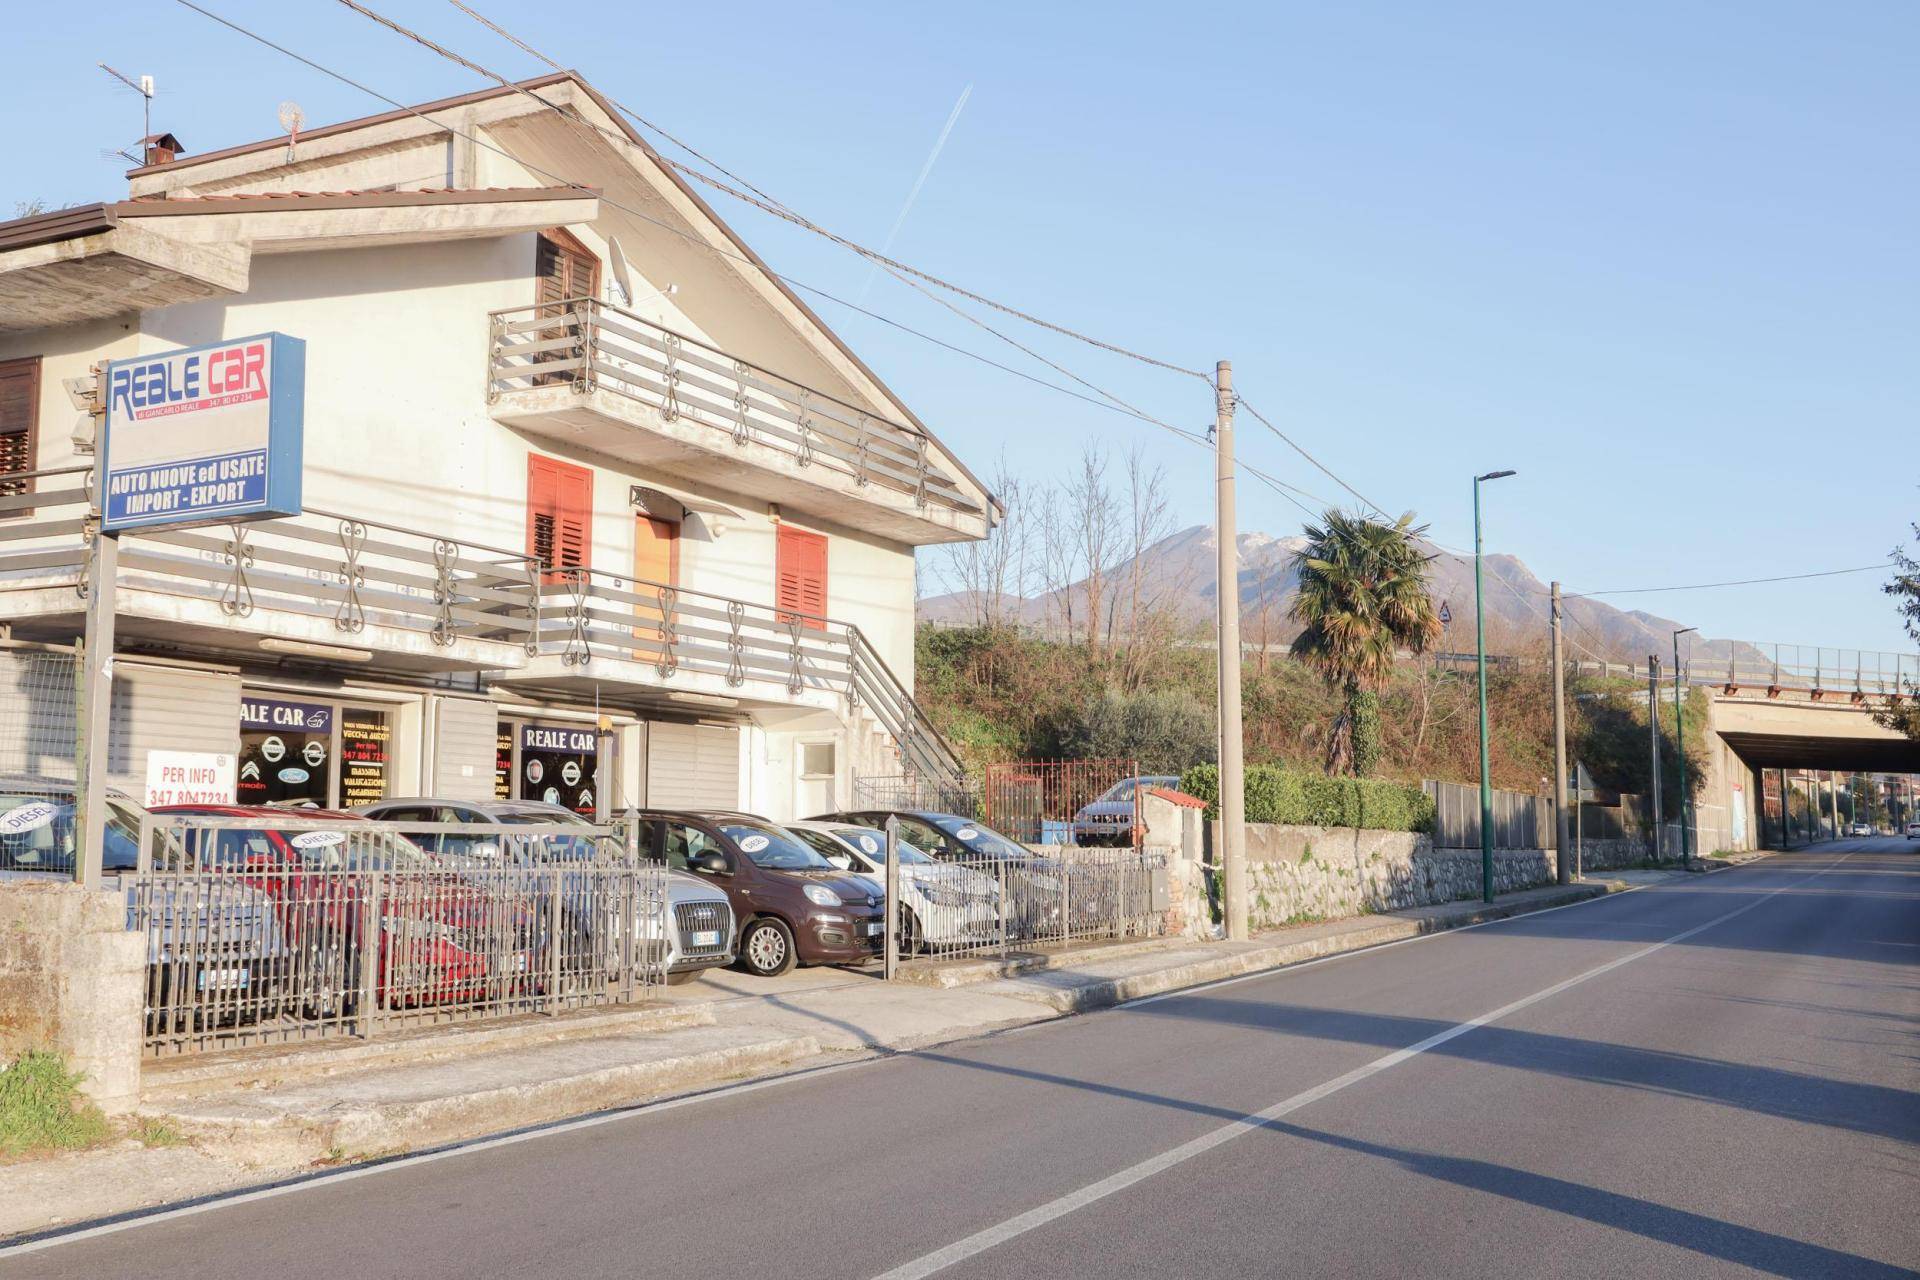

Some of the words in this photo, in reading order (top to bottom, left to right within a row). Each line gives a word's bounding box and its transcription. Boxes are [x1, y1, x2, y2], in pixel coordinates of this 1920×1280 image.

[181, 402, 200, 412] REALE
[111, 473, 147, 495] AUTO
[149, 465, 196, 490] NUOVE
[199, 463, 217, 482] ed
[219, 455, 265, 478] USATE
[126, 490, 181, 514] IMPORT
[190, 481, 246, 506] EXPORT
[240, 703, 269, 723] ALE
[273, 706, 304, 726] CAR
[526, 729, 567, 749] REALE
[570, 733, 595, 751] CAR
[162, 766, 185, 783] PER
[189, 767, 216, 784] INFO
[150, 790, 173, 806] 347
[7, 806, 52, 828] DIESEL
